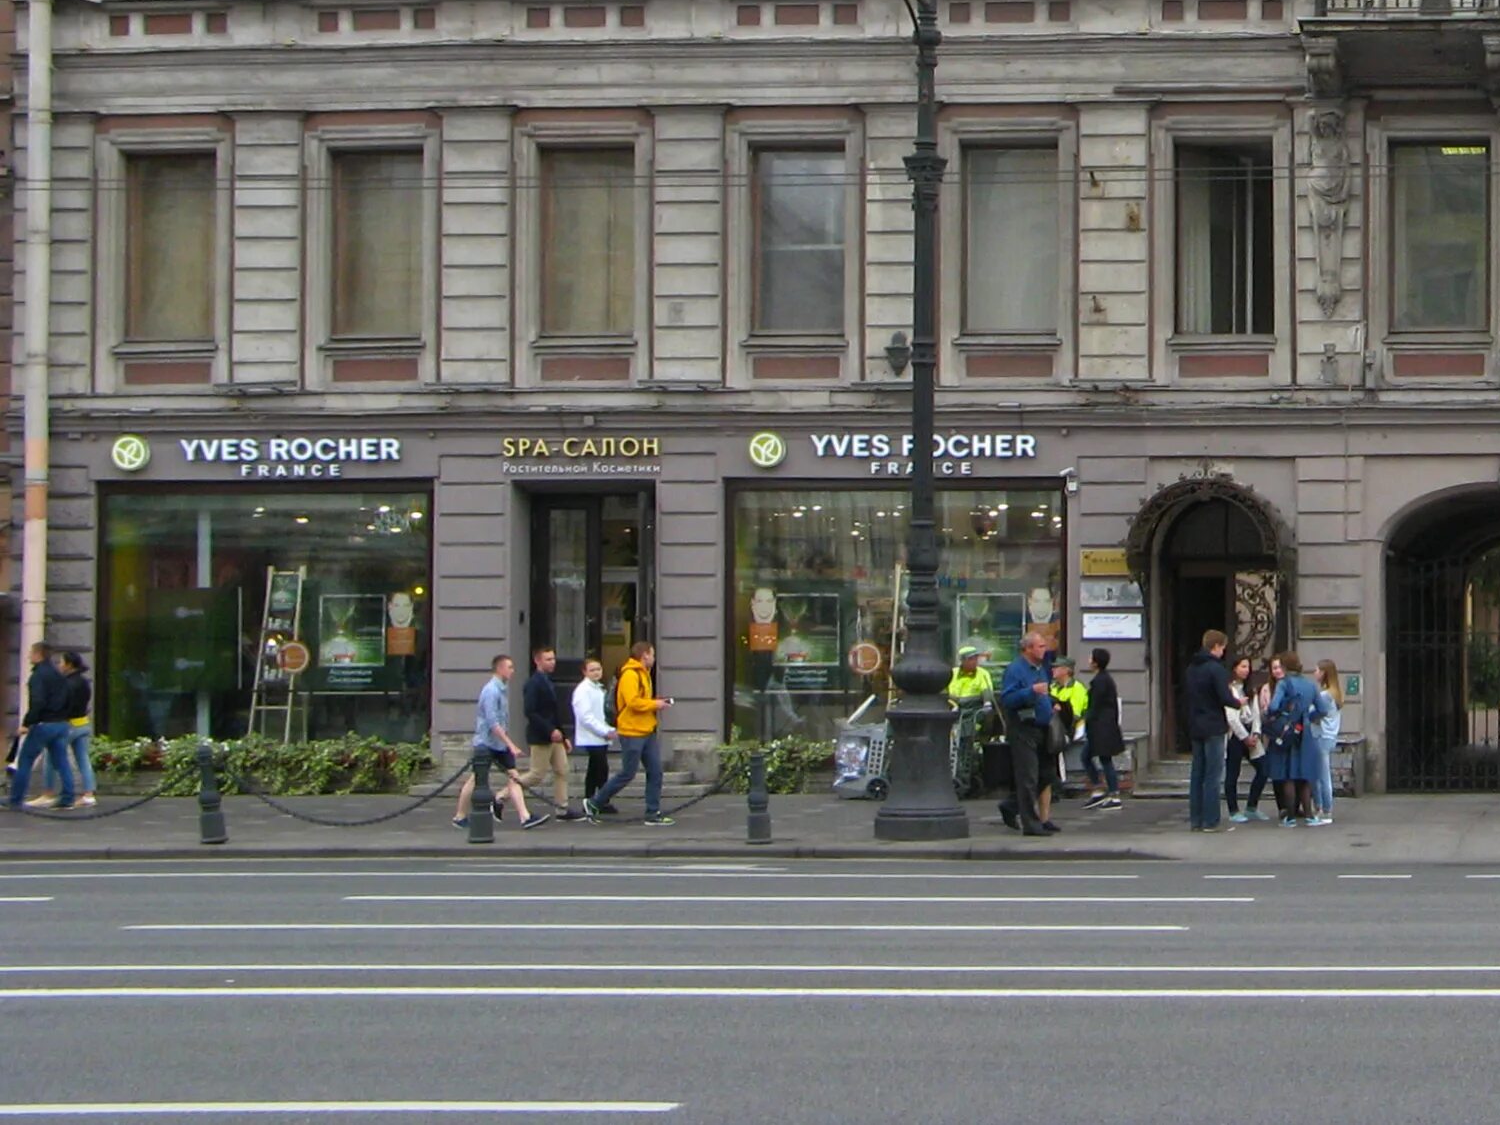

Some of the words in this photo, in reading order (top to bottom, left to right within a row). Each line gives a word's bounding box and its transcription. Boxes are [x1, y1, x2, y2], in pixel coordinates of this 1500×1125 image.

[180, 437, 259, 462] YVES
[269, 437, 400, 461] ROCHER
[502, 437, 660, 457] SPA-САЛОН
[810, 434, 890, 457] YVES
[240, 463, 342, 477] FRANCE
[593, 462, 661, 473] Косметики
[870, 461, 972, 474] FRACE
